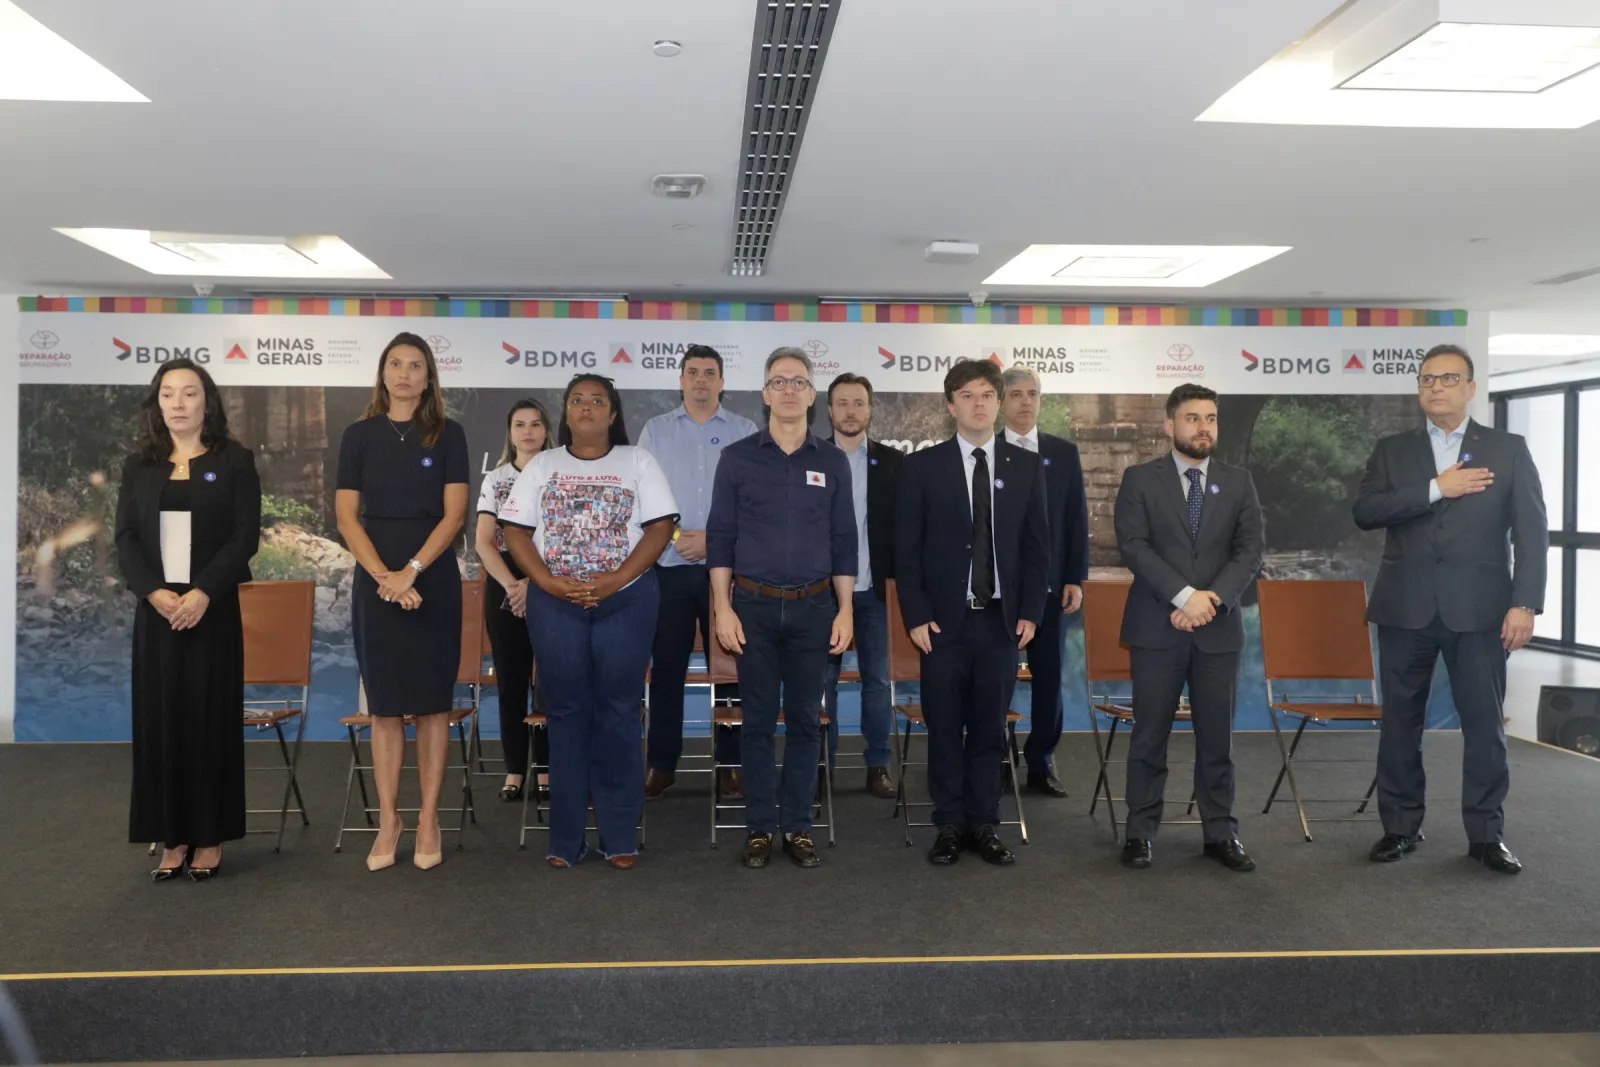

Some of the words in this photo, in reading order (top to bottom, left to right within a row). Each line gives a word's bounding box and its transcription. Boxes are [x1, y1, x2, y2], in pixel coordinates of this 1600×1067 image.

[257, 338, 314, 351] MINAS
[136, 347, 210, 364] BDMG
[257, 352, 323, 366] GERAIS
[525, 350, 597, 368] BDMG
[1013, 347, 1067, 359] MINAS
[1373, 348, 1425, 360] MINAS
[641, 357, 683, 369] GER
[1156, 363, 1204, 372] REPARAÇÃO
[1263, 358, 1331, 374] BDMG
